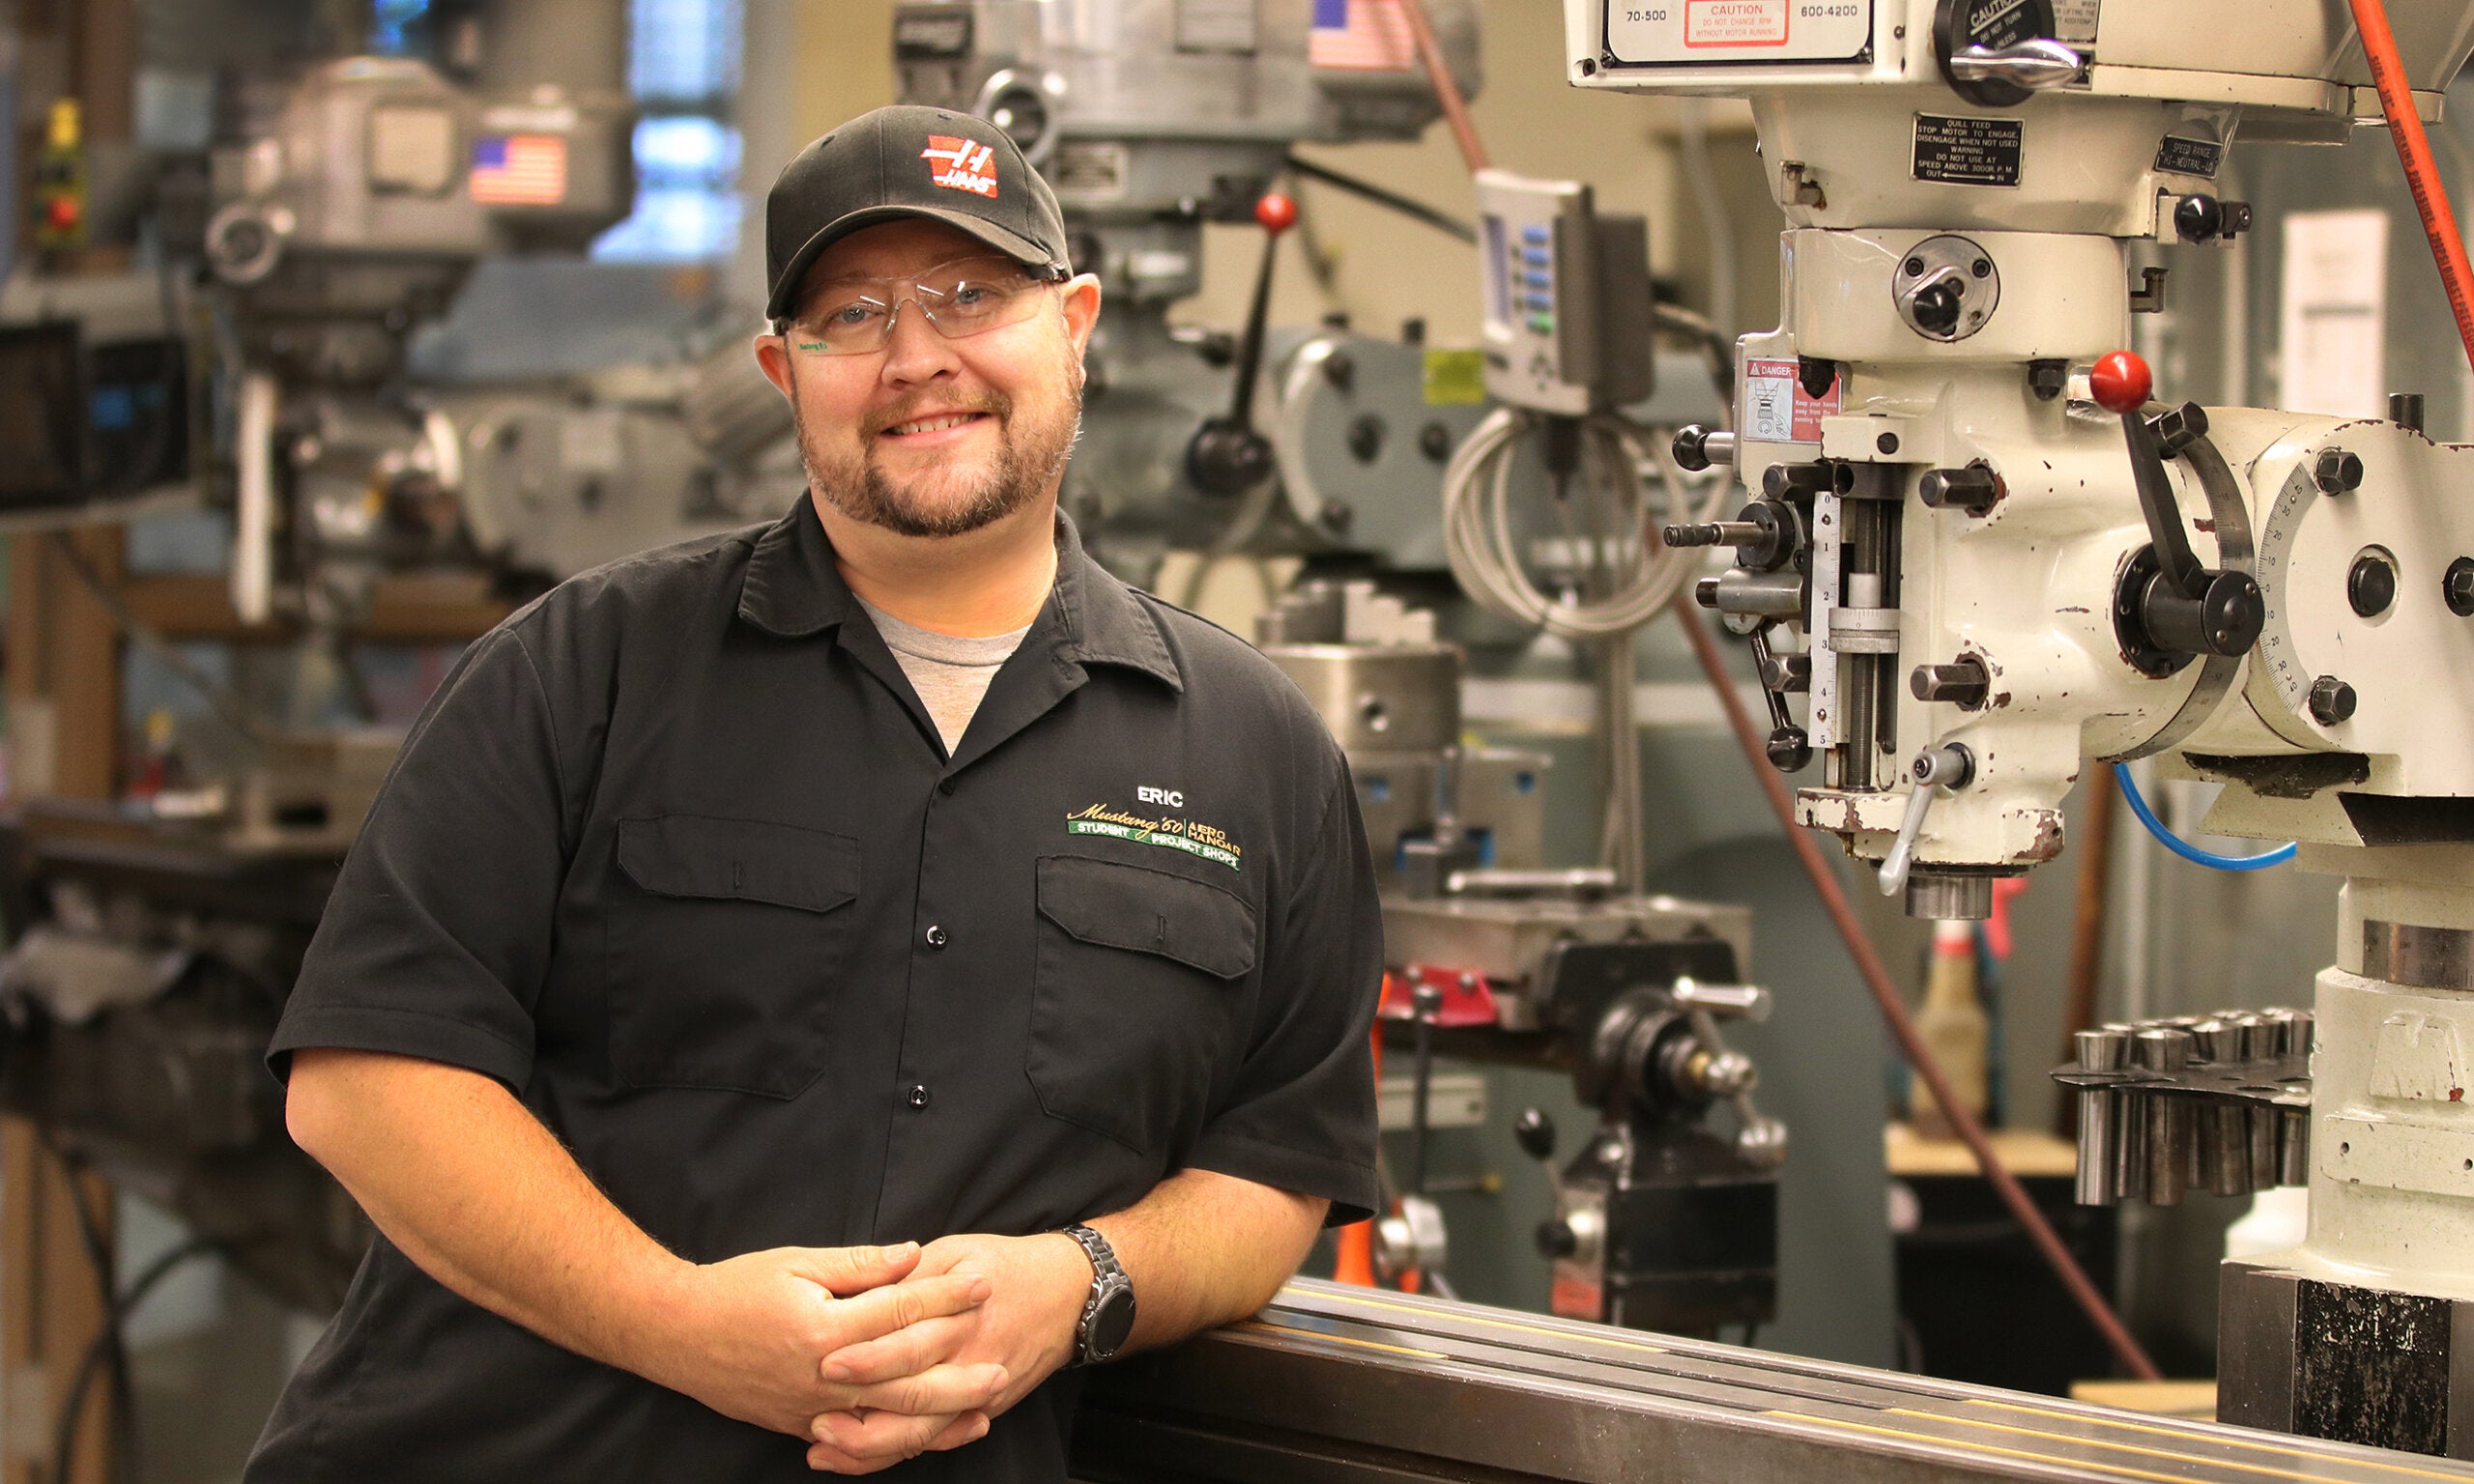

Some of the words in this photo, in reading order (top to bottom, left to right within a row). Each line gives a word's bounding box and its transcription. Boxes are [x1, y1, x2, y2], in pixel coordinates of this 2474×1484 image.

[1711, 5, 1763, 15] CAUTION
[1971, 0, 2017, 27] CAUTIO
[1731, 17, 1755, 26] CHANGE
[2004, 11, 2022, 26] TURN
[1971, 121, 1991, 129] FEED
[1917, 134, 1957, 144] DISENGAGE
[2391, 118, 2415, 168] WORKING
[1950, 146, 1983, 155] WARNING
[2172, 142, 2191, 155] SPEED
[2192, 146, 2211, 158] RANGE
[1917, 159, 1941, 168] SPEED
[1944, 162, 1968, 171] ABOVE
[934, 168, 997, 193] HAAS
[1762, 366, 1791, 376] DANGER
[1825, 495, 1830, 503] 0
[2282, 505, 2290, 517] 30
[2273, 529, 2282, 541] 20
[1825, 543, 1828, 552] 1
[2268, 556, 2276, 566] 10
[2265, 584, 2271, 592] 0
[2267, 610, 2275, 619] 10
[1822, 641, 1827, 649] 3
[2271, 636, 2280, 646] 20
[2278, 660, 2287, 671] 30
[2289, 681, 2298, 693] 40
[1821, 688, 1827, 697] 4
[1820, 735, 1827, 744] 5
[1137, 785, 1184, 808] ERIC
[1067, 803, 1159, 841] Mustang
[1189, 821, 1225, 841] AERO
[1078, 823, 1130, 838] STUDENT
[1151, 833, 1201, 854] PROJECT
[1203, 846, 1237, 868] SHOPS
[1188, 830, 1241, 857] HANGAR
